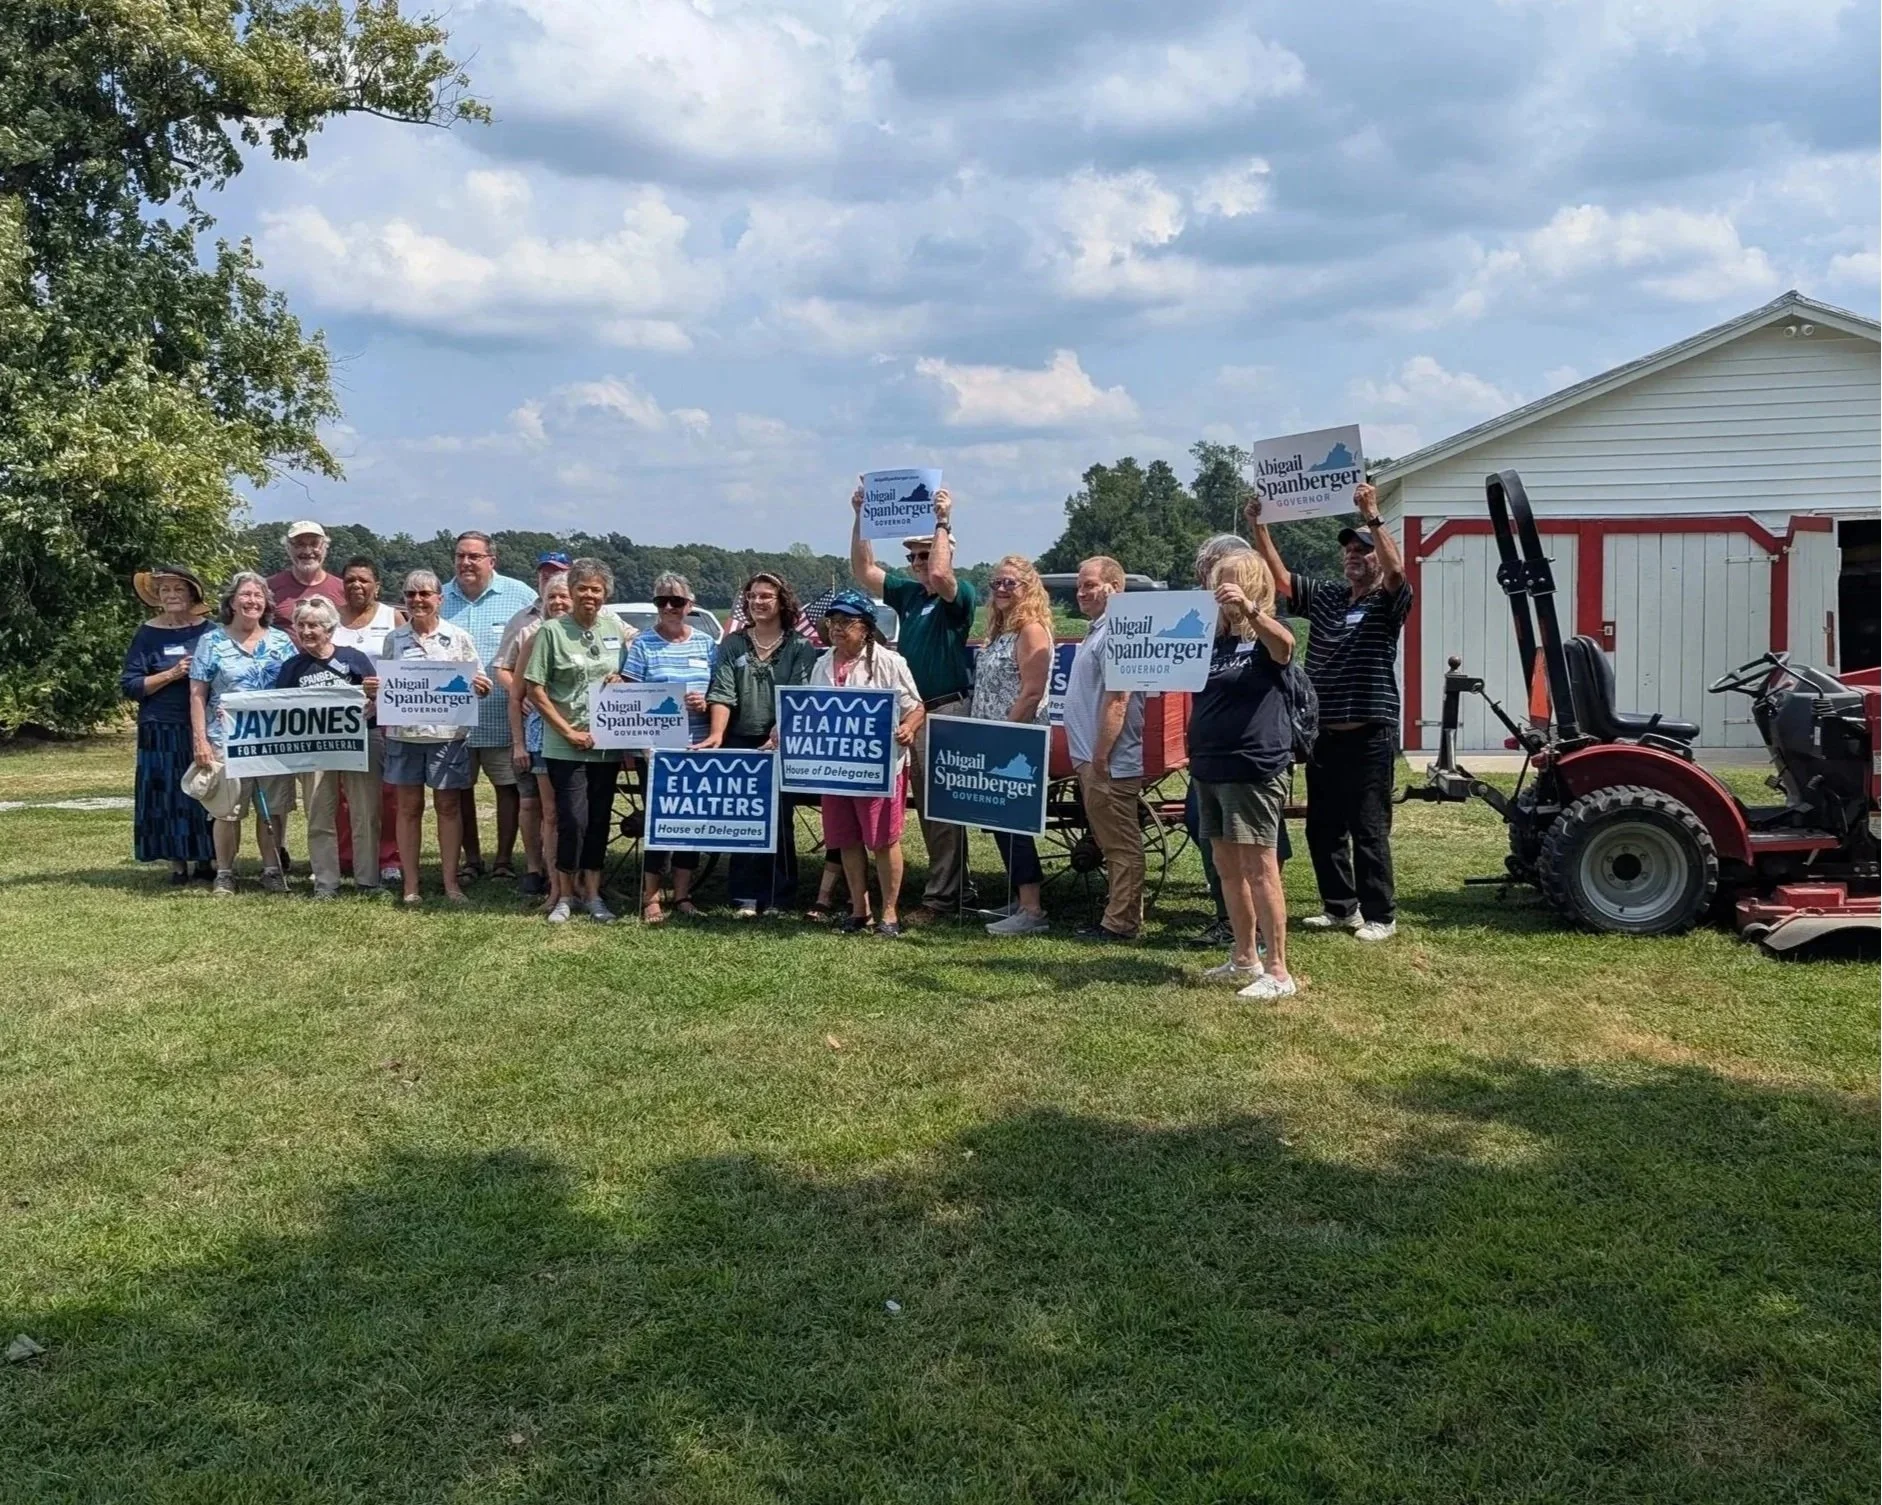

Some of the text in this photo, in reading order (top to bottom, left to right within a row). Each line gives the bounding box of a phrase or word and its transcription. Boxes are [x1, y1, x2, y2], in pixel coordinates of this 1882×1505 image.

[1256, 454, 1303, 478] Abigail
[1256, 469, 1361, 500] Spanberger
[865, 489, 896, 504] Abigail
[1276, 493, 1330, 507] GOVERNOR
[863, 502, 934, 520] Spanberger
[874, 518, 911, 526] GOVERNOR
[1107, 616, 1153, 639] Abigail
[1106, 637, 1208, 664] Spanberger
[1120, 665, 1170, 674] GOVERNOR
[384, 678, 429, 692] Abigail
[384, 690, 473, 707] Spanberger
[596, 700, 641, 715] Abigail
[596, 713, 684, 730] Spanberger
[792, 715, 876, 736] ELAINE
[238, 739, 357, 756] FOR ATTORNEY GENERAL
[785, 736, 883, 759] WALTERS
[935, 749, 986, 772] Abigail
[785, 765, 880, 779] House of Delegates
[667, 776, 758, 795] ELAINE
[934, 766, 1036, 799] Spanberger
[659, 796, 765, 816] WALTERS
[952, 791, 1006, 806] GOVERNOR
[657, 824, 762, 837] House of Delegates
